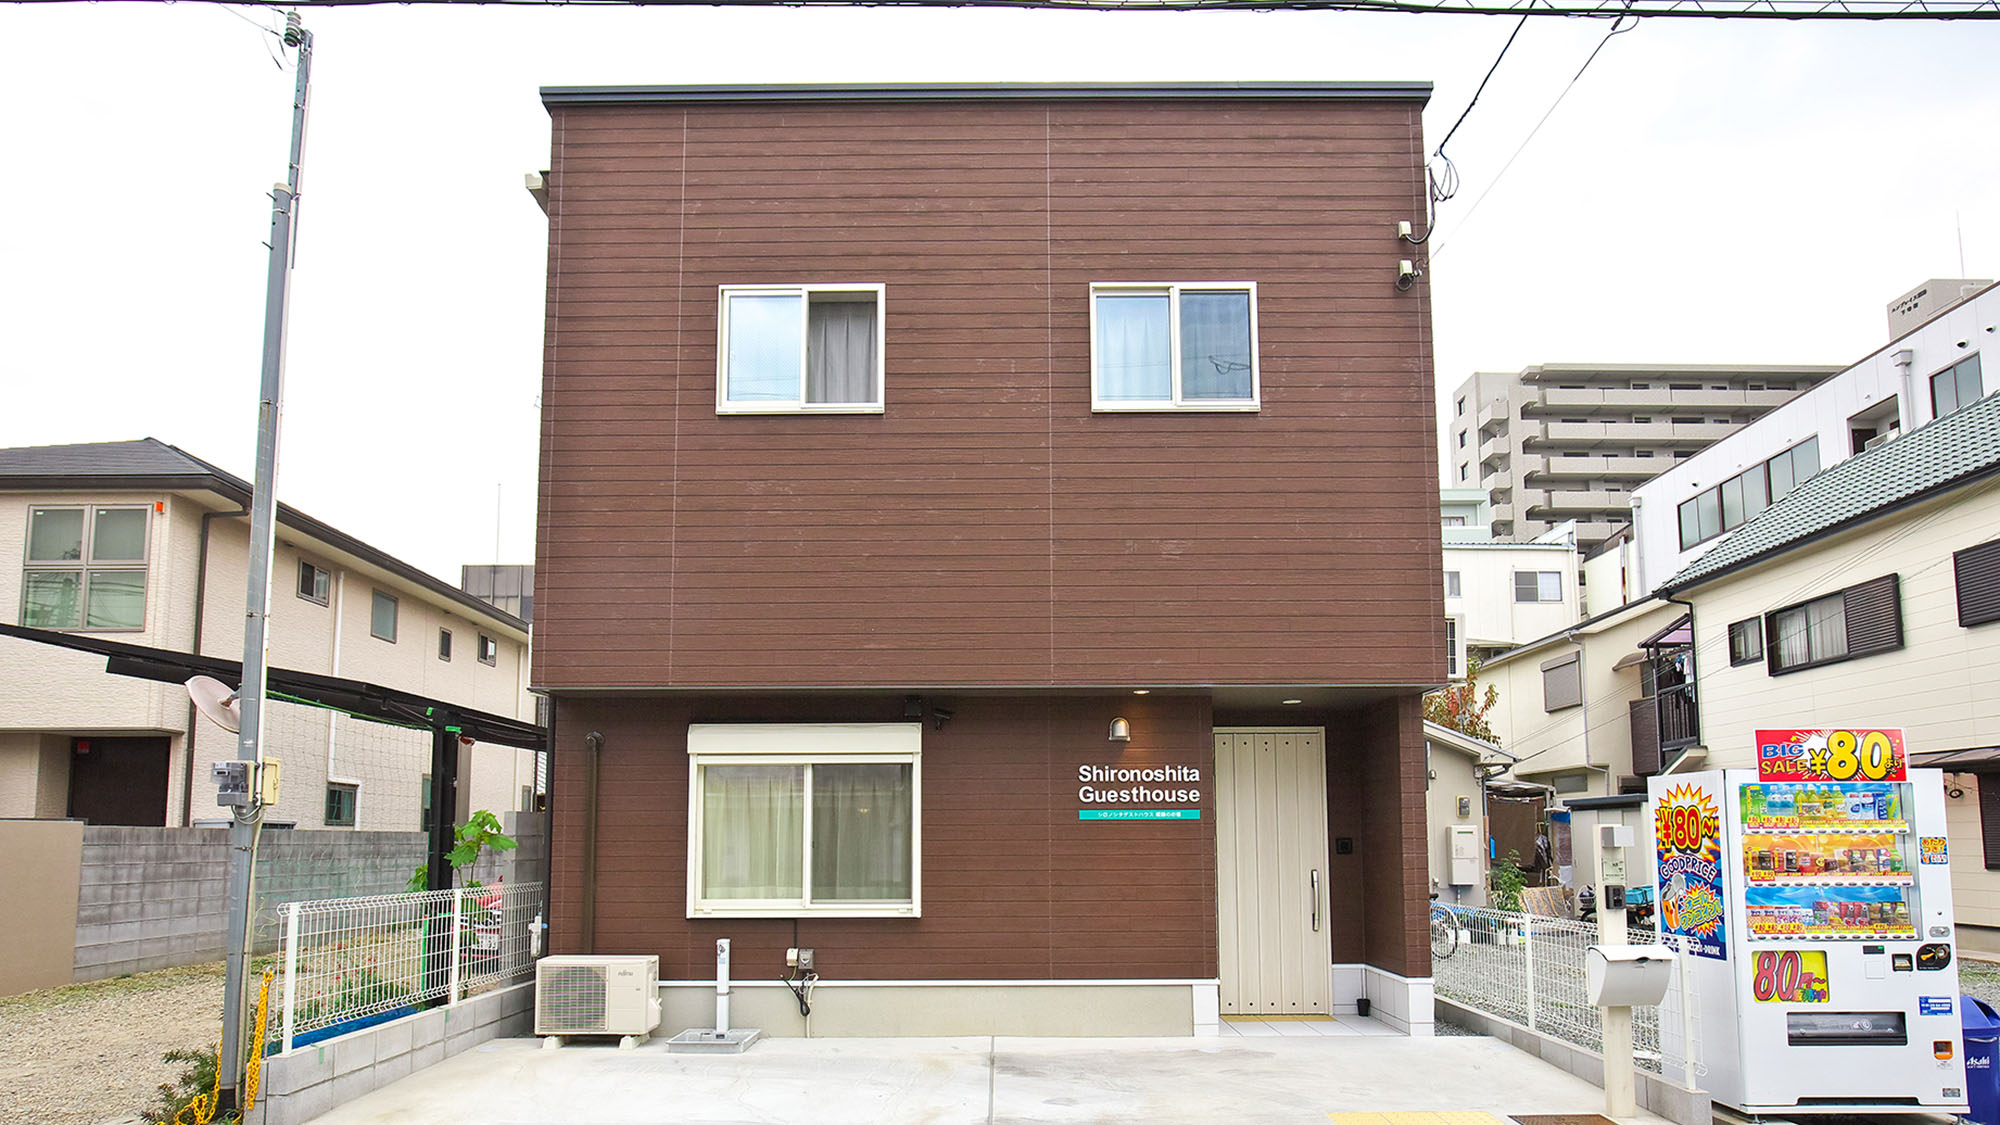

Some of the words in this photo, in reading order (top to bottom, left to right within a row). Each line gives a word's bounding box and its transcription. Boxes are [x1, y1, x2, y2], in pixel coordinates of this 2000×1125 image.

[1762, 744, 1804, 758] BIG
[1078, 765, 1200, 782] Shironoshita
[1760, 759, 1809, 774] SALE
[1078, 786, 1200, 803] Guesthouse
[1685, 890, 1709, 912] オール
[1966, 1056, 1990, 1065] Asahi
